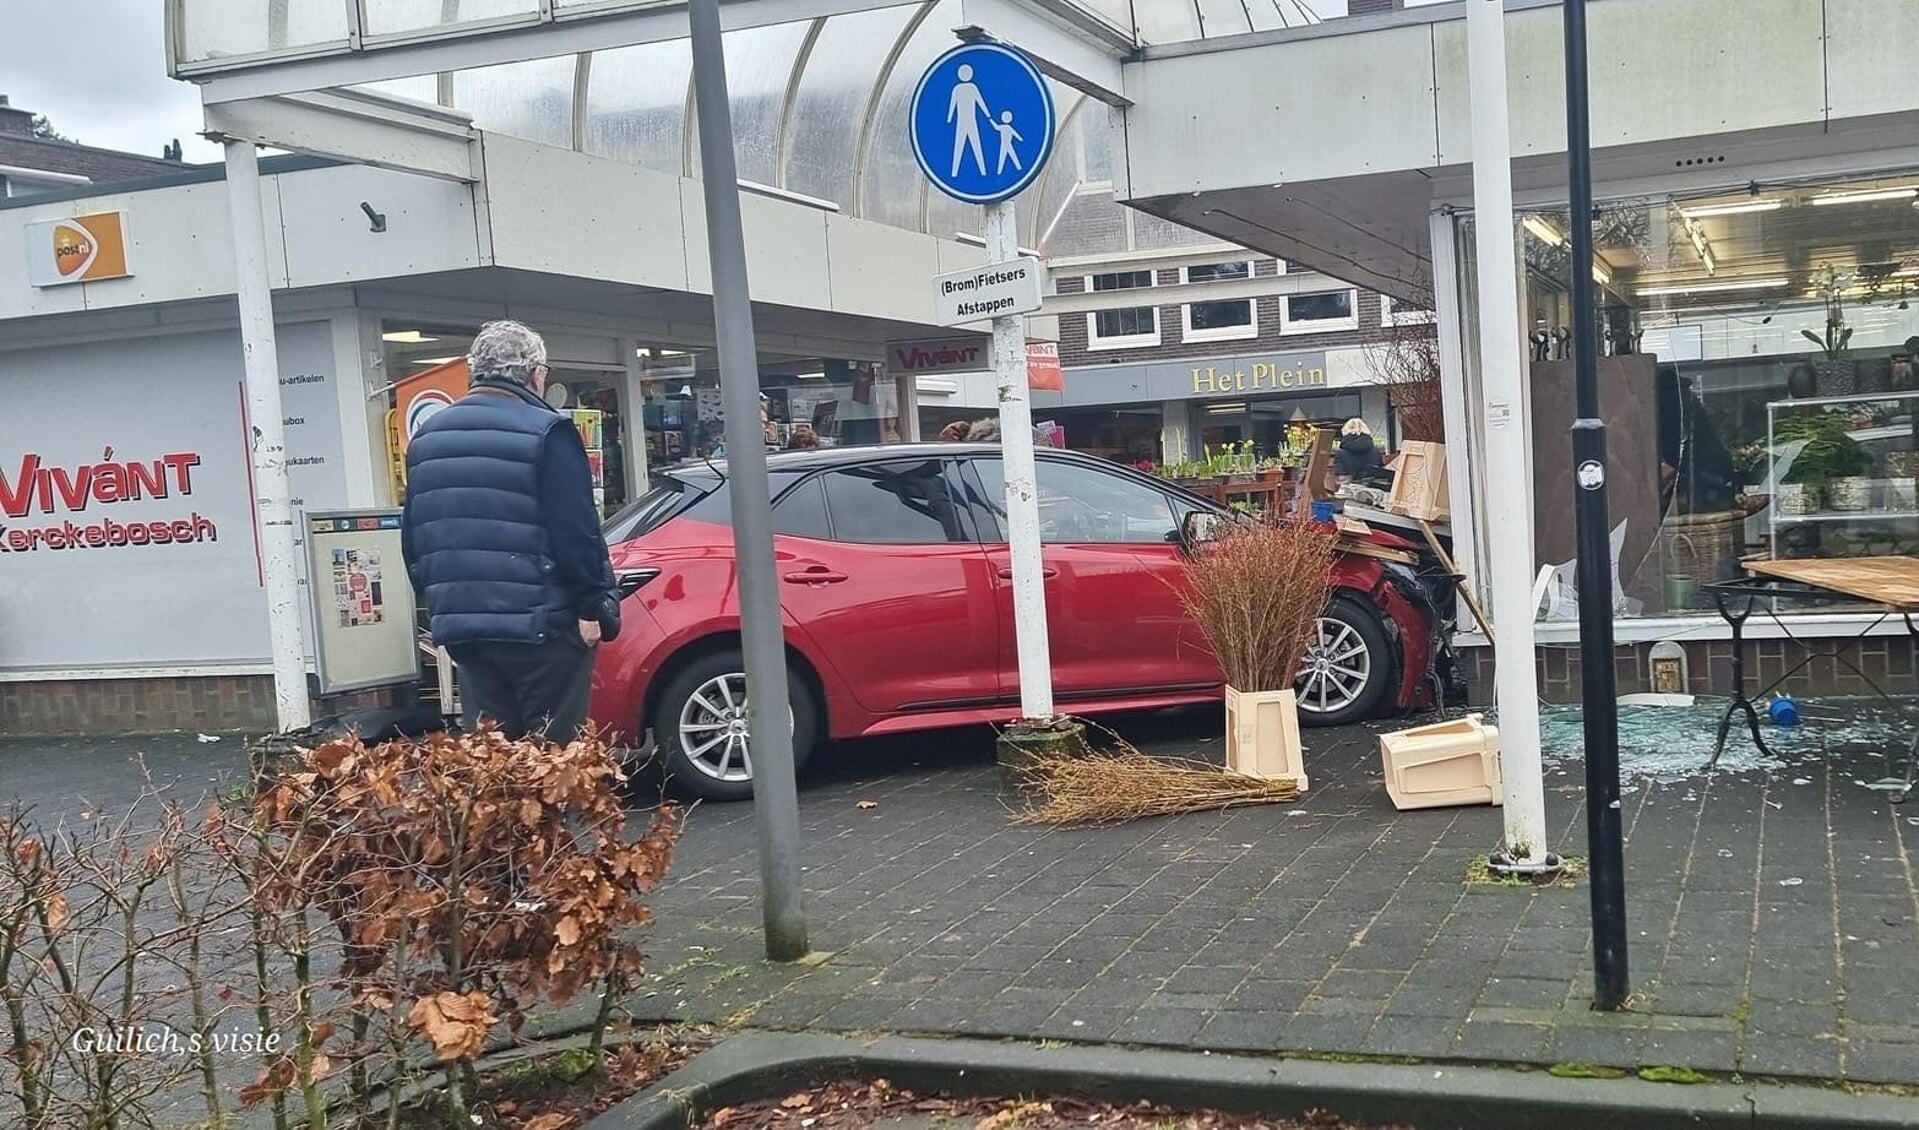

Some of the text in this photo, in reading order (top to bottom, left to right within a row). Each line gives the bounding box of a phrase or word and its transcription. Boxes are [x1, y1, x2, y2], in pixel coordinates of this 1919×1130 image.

[57, 241, 89, 258] postnl
[940, 267, 1026, 297] (Brom)Fietsers
[956, 296, 1015, 317] Afstappen
[1191, 360, 1325, 393] Het Plein
